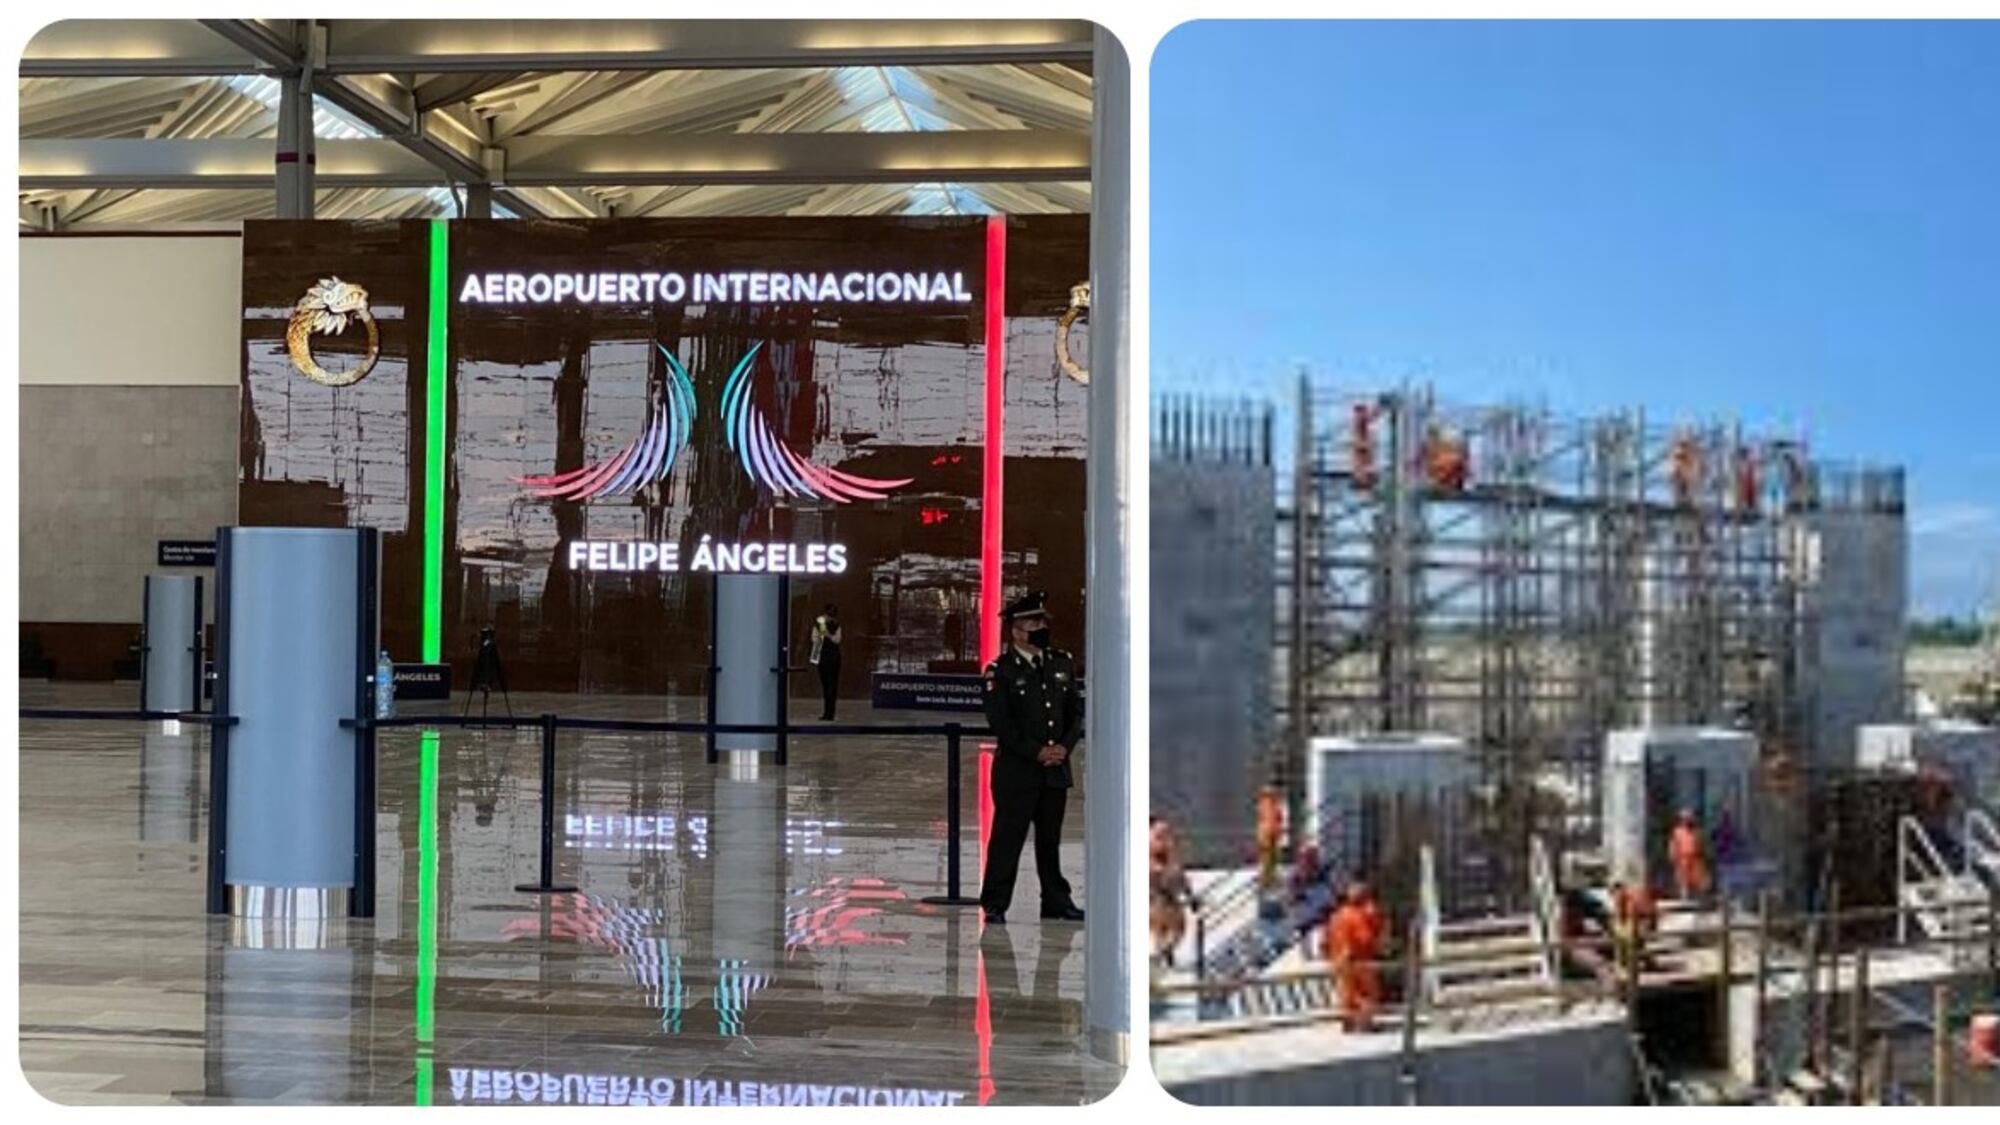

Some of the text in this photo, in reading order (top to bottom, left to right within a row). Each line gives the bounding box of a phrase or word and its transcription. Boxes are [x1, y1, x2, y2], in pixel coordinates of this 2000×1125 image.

[459, 271, 972, 303] AEROPUERTO INTERNACIONAL
[568, 534, 848, 573] FELIPE ÁNGELES
[881, 682, 982, 693] AEROPUERTO INTERNACI
